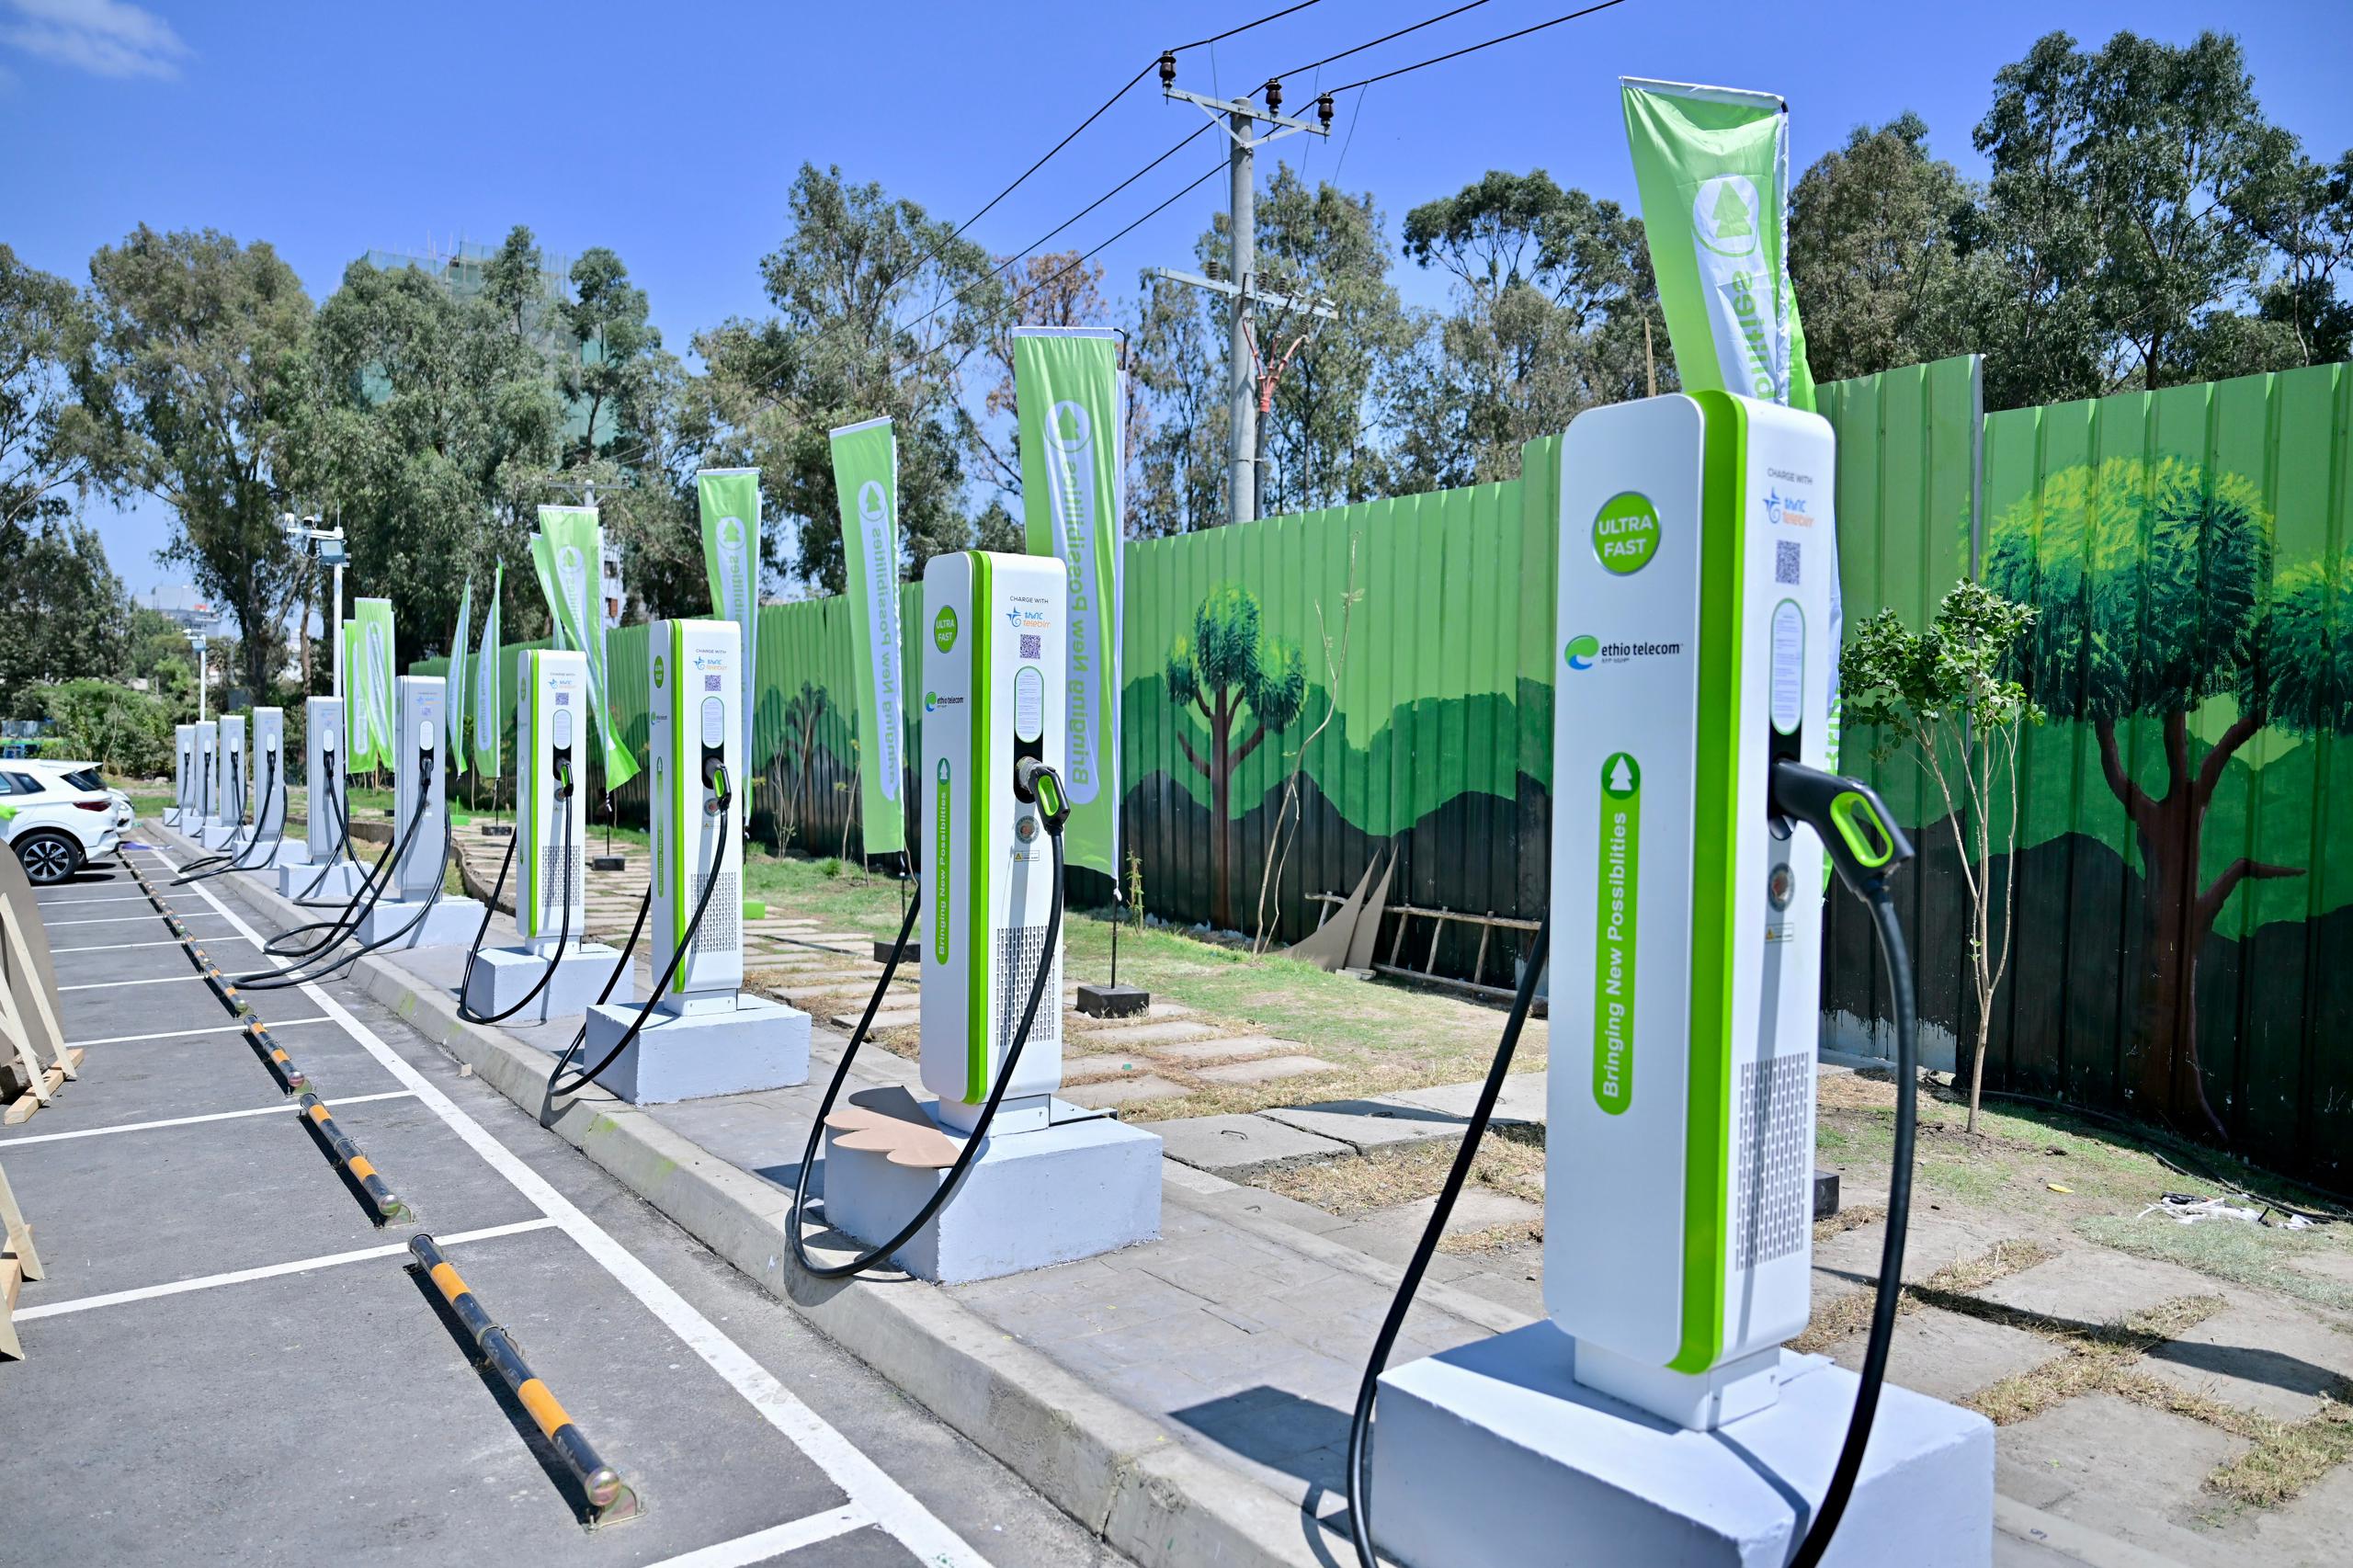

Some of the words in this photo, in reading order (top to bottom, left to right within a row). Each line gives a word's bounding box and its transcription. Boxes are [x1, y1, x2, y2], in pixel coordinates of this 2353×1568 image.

[1767, 467, 1795, 483] CHARGE
[1796, 475, 1813, 485] WITH
[1598, 515, 1653, 536] ULTRA
[1604, 539, 1647, 557] FAST
[1009, 596, 1034, 604] CHARGE
[936, 619, 955, 630] ULTRA
[938, 631, 953, 642] FAST
[1601, 642, 1631, 656] ethio
[1632, 642, 1680, 655] telecom
[1607, 812, 1627, 941] Possiblities
[938, 901, 947, 955] Bringing
[1605, 947, 1623, 995] New
[1602, 1002, 1625, 1098] Bringing
